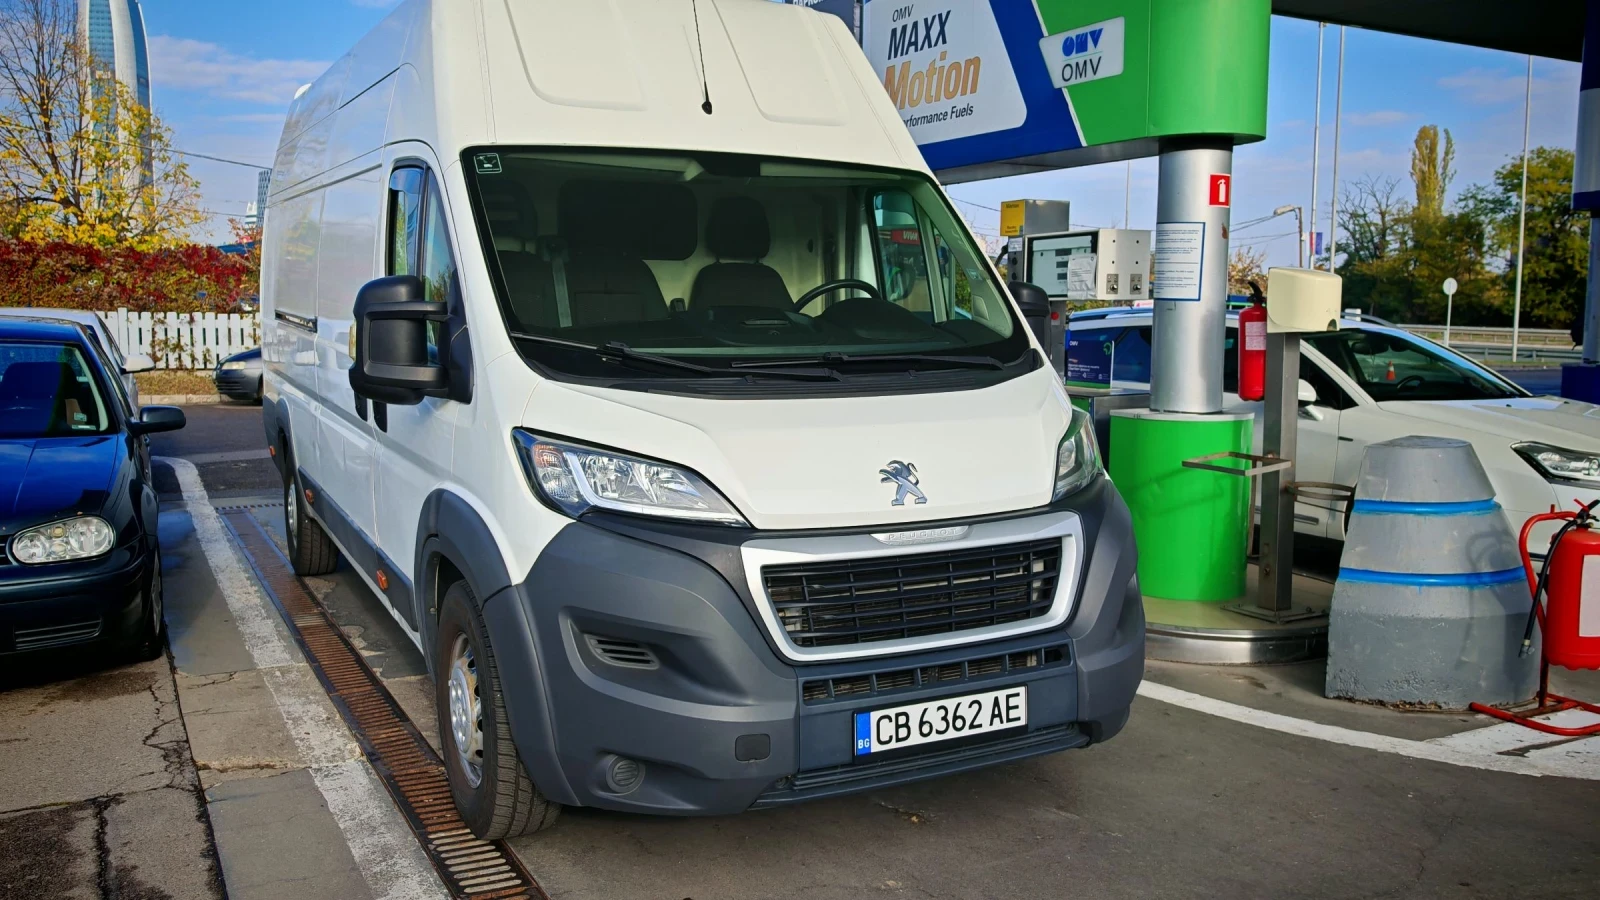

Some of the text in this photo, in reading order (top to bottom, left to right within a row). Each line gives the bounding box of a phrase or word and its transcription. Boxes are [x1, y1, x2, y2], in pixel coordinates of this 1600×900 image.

[892, 4, 914, 22] OMV
[887, 9, 952, 60] MAXX
[884, 50, 981, 110] Motion
[1061, 56, 1102, 82] OMV
[949, 103, 974, 120] Fuels
[888, 525, 957, 541] PEUGEOT
[876, 692, 1021, 745] CB 6362 AE
[857, 738, 870, 749] BG
